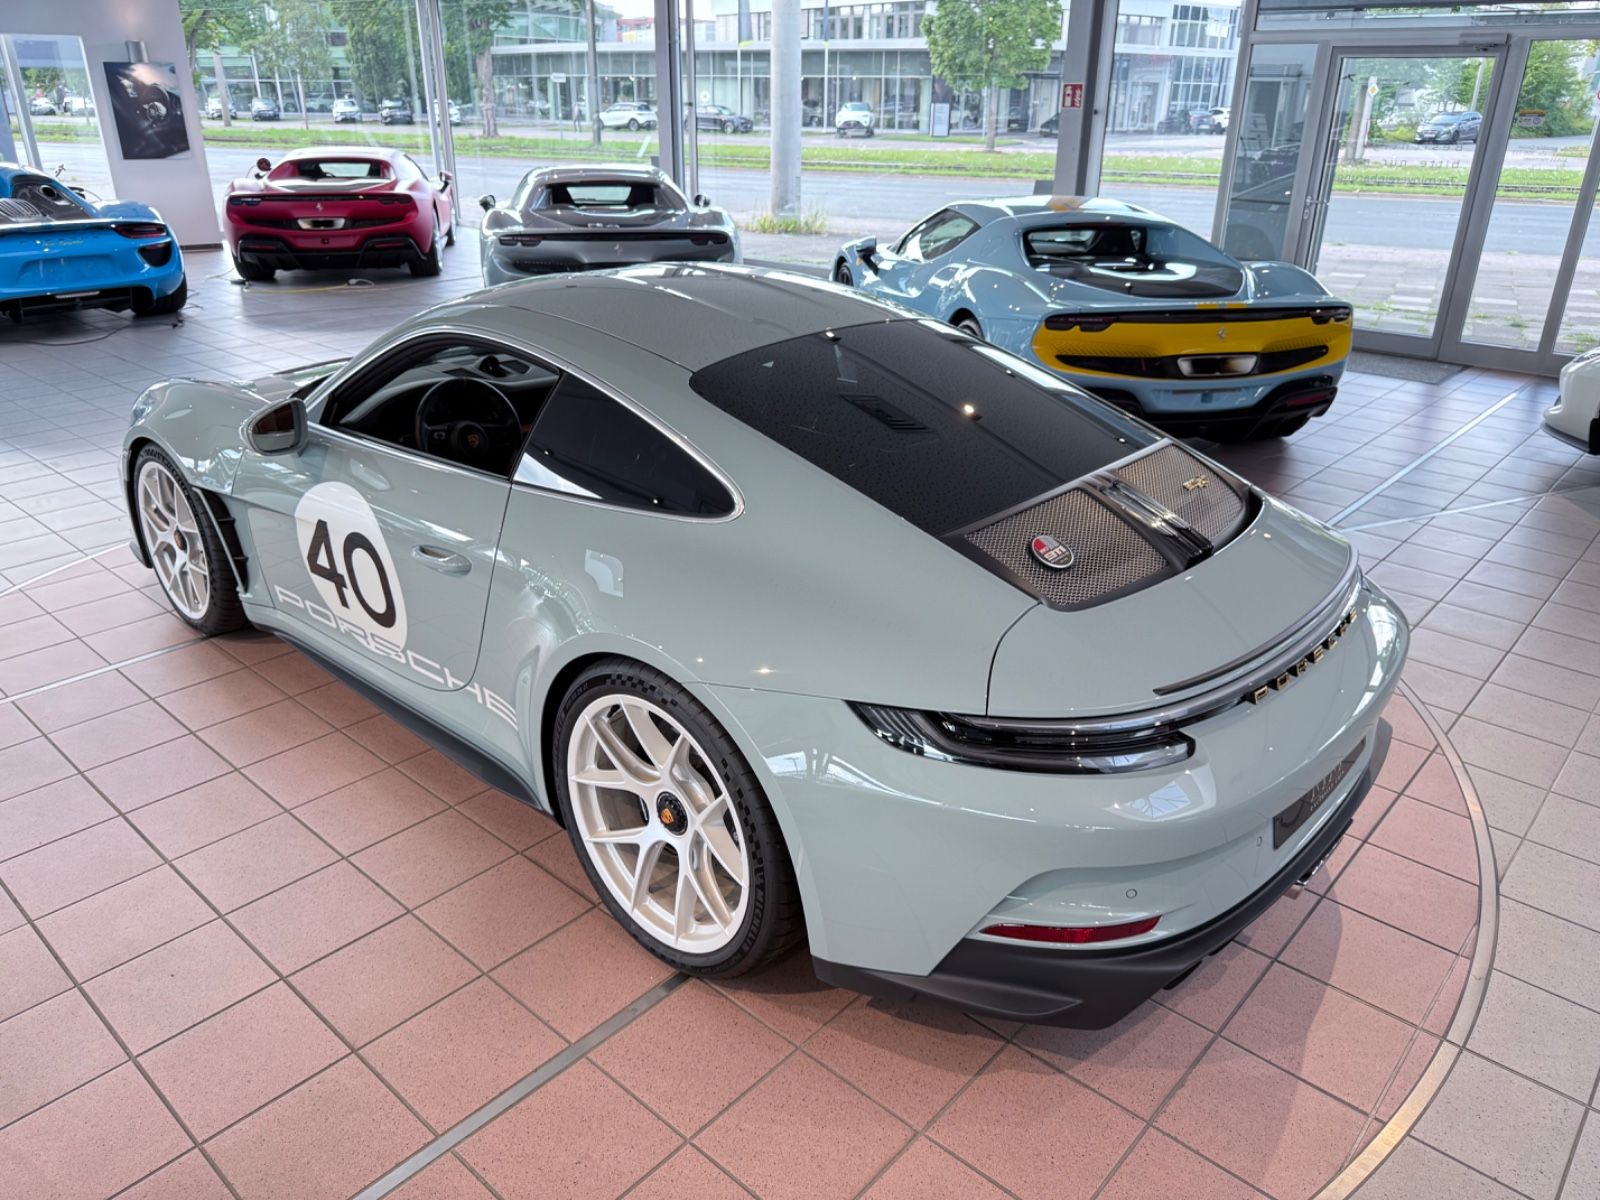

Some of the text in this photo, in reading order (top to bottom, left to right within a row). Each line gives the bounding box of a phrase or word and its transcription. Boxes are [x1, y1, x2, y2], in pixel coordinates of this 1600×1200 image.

[307, 518, 397, 628] 40
[273, 584, 519, 730] PORSCHE
[1253, 606, 1358, 705] PORSCHE
